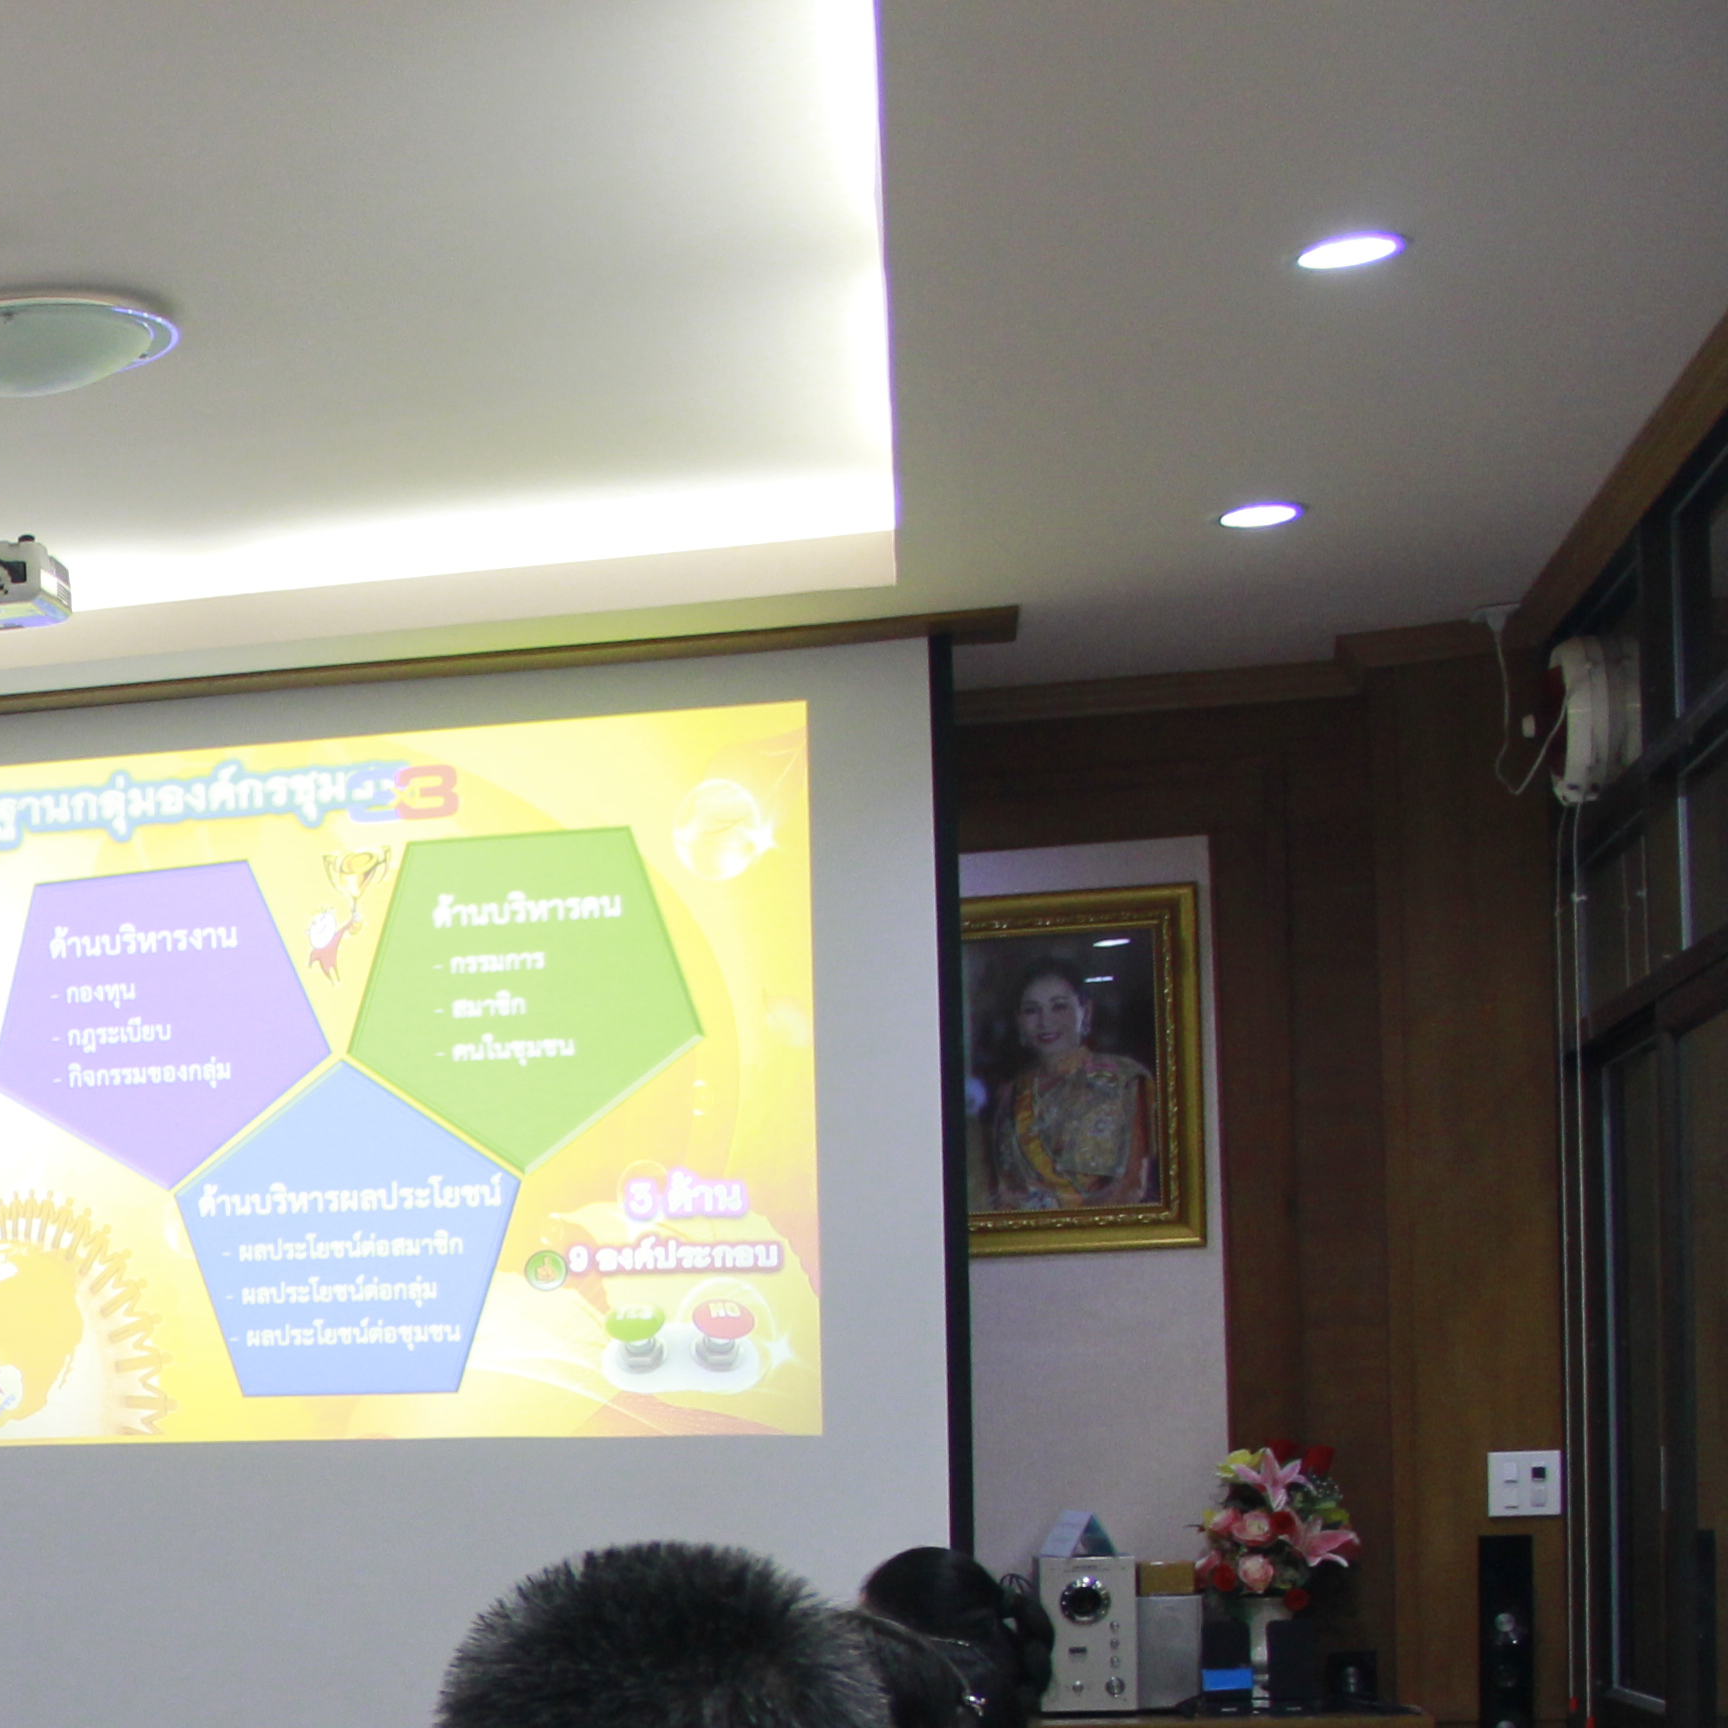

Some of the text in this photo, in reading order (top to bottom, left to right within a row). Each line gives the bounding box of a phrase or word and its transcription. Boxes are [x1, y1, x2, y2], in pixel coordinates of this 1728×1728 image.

[432, 889, 622, 928] ด้านบริหารคน
[48, 922, 238, 960] ด้านบริหารงาน
[66, 982, 136, 1009] กองทุน
[67, 1056, 232, 1089] กิจกรรมของกลุ่ม
[198, 1172, 503, 1218] ด้านบริหารผลประโยชน์
[238, 1228, 464, 1262] ผลประโยชน์ต่อสมาชิก
[241, 1274, 438, 1308] ผลประโยชน์ต่อกลุ่ม
[246, 1317, 462, 1352] ผลประโยชน์ต่อชุมชน
